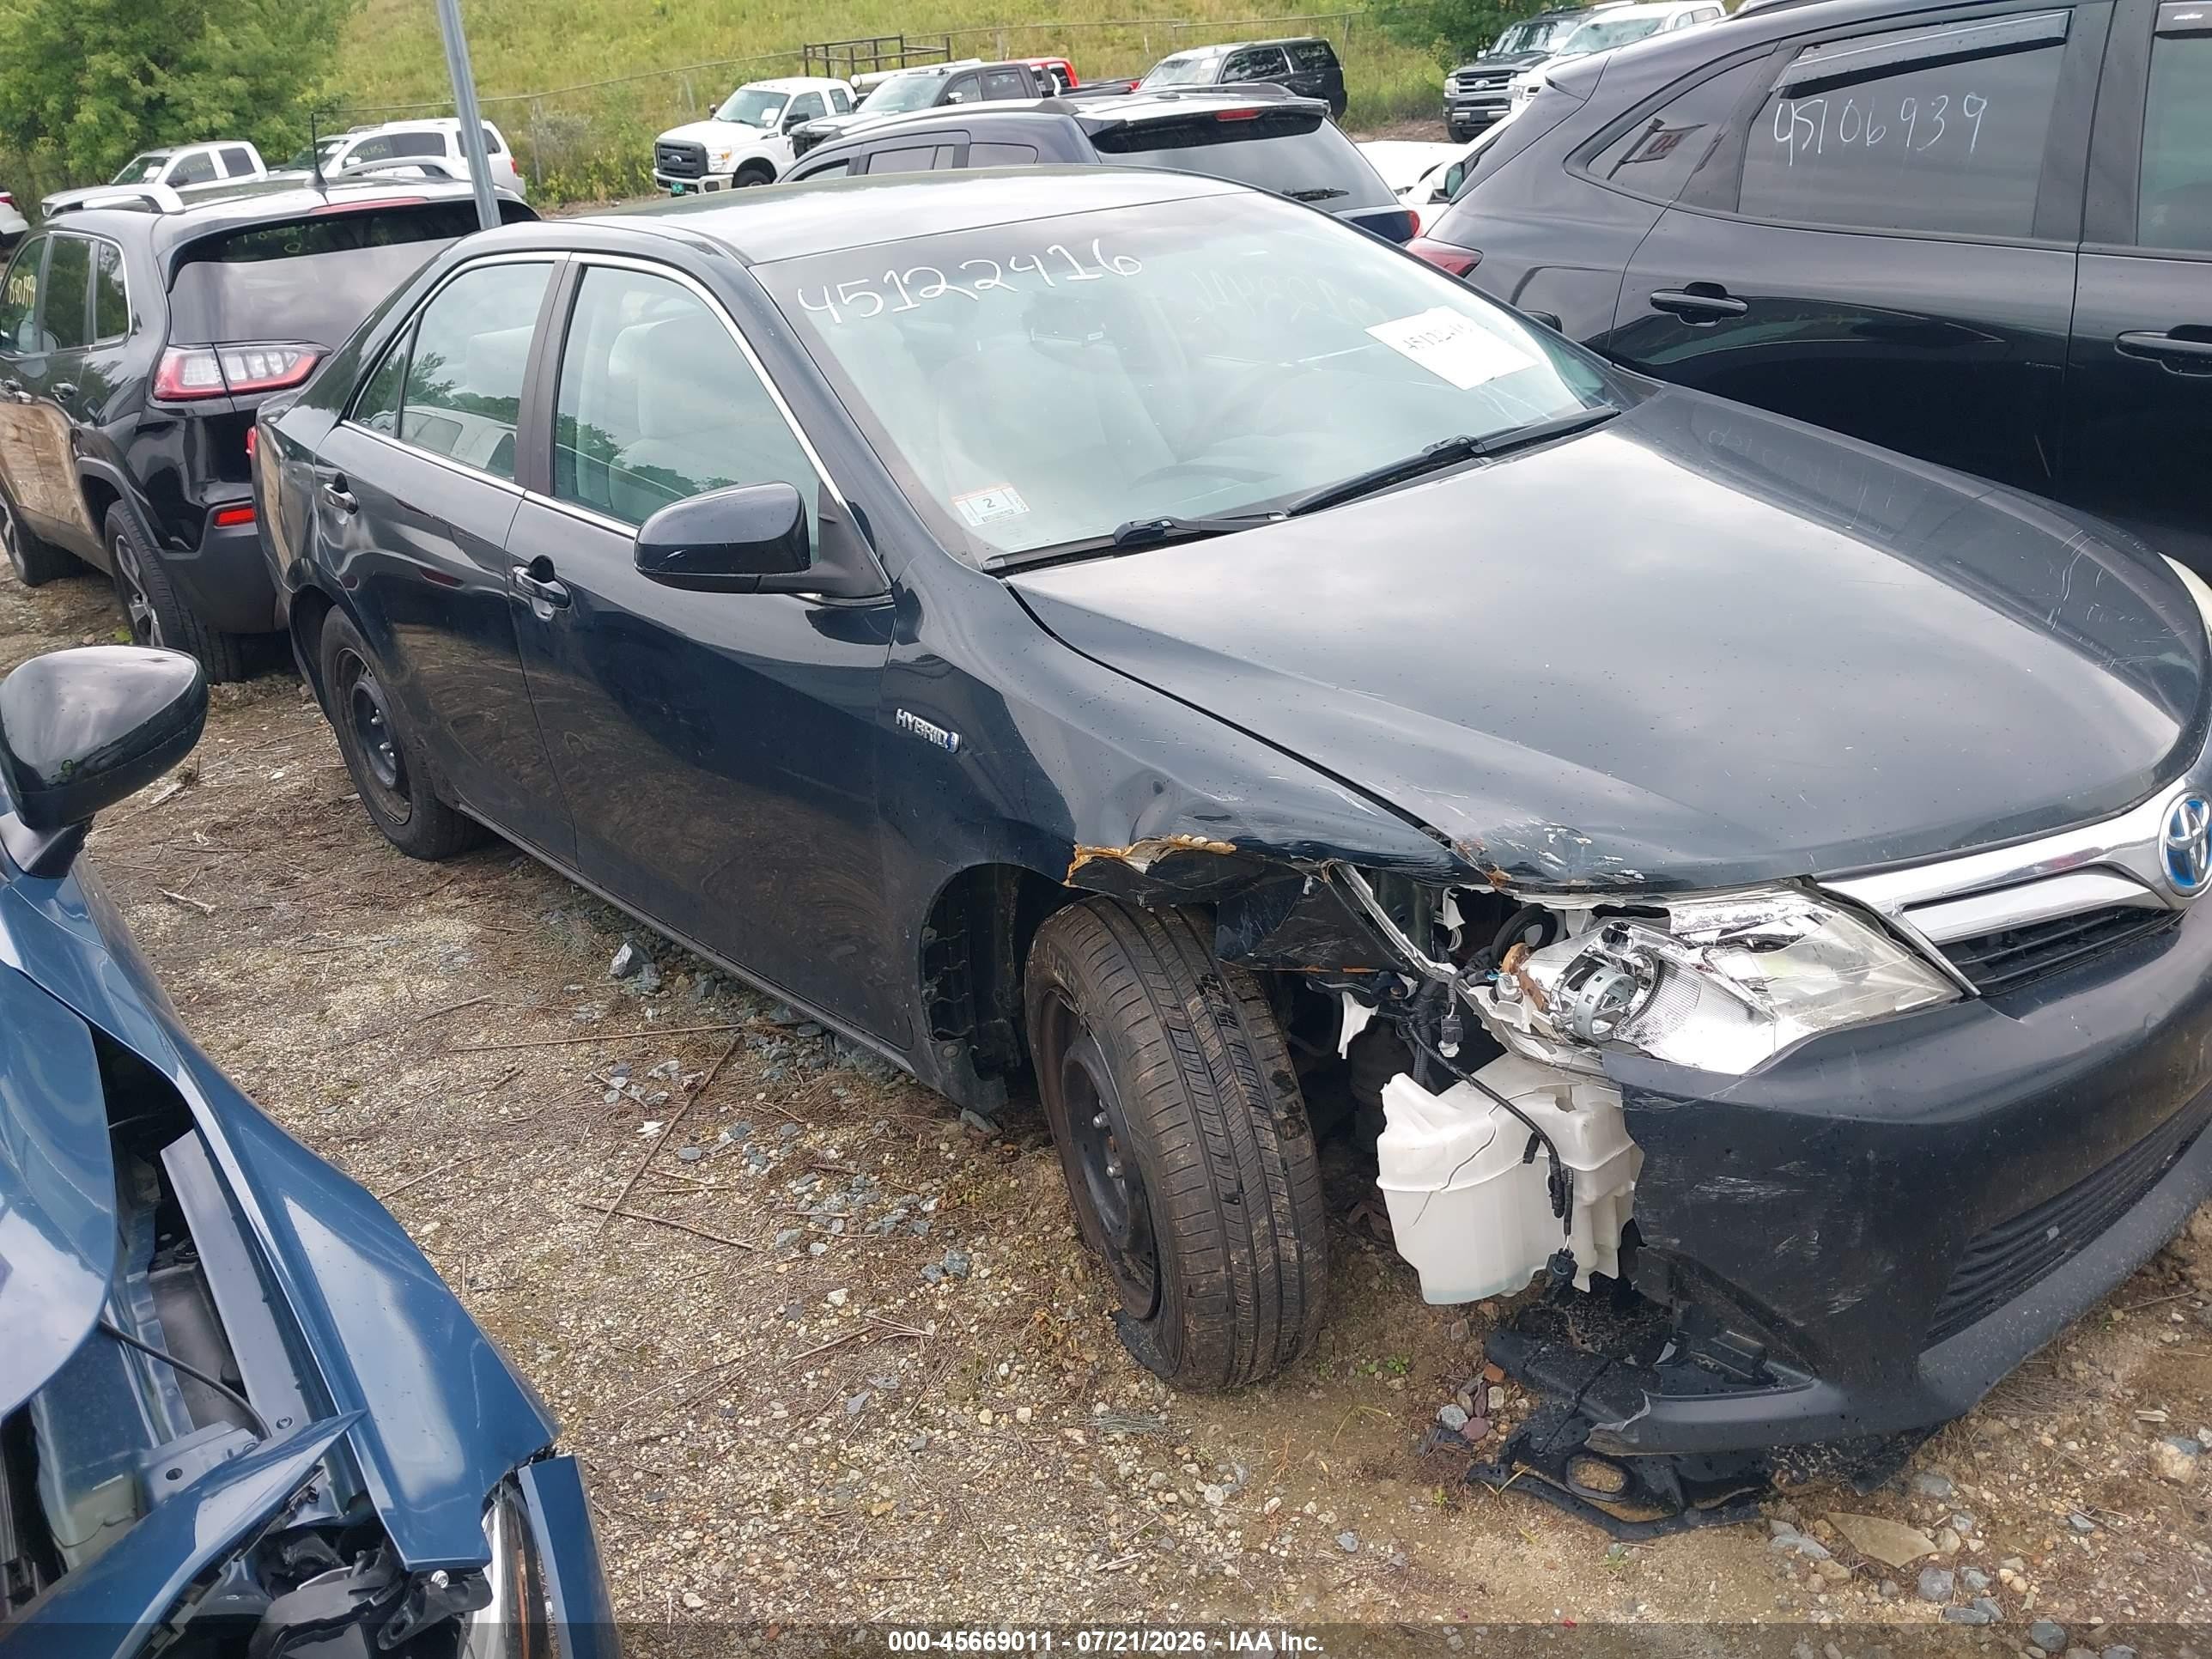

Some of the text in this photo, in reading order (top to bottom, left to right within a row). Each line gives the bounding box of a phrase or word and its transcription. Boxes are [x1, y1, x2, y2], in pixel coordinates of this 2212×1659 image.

[1774, 92, 1988, 166] 45106939
[797, 238, 1143, 325] 45122416
[895, 708, 949, 750] HYBRID
